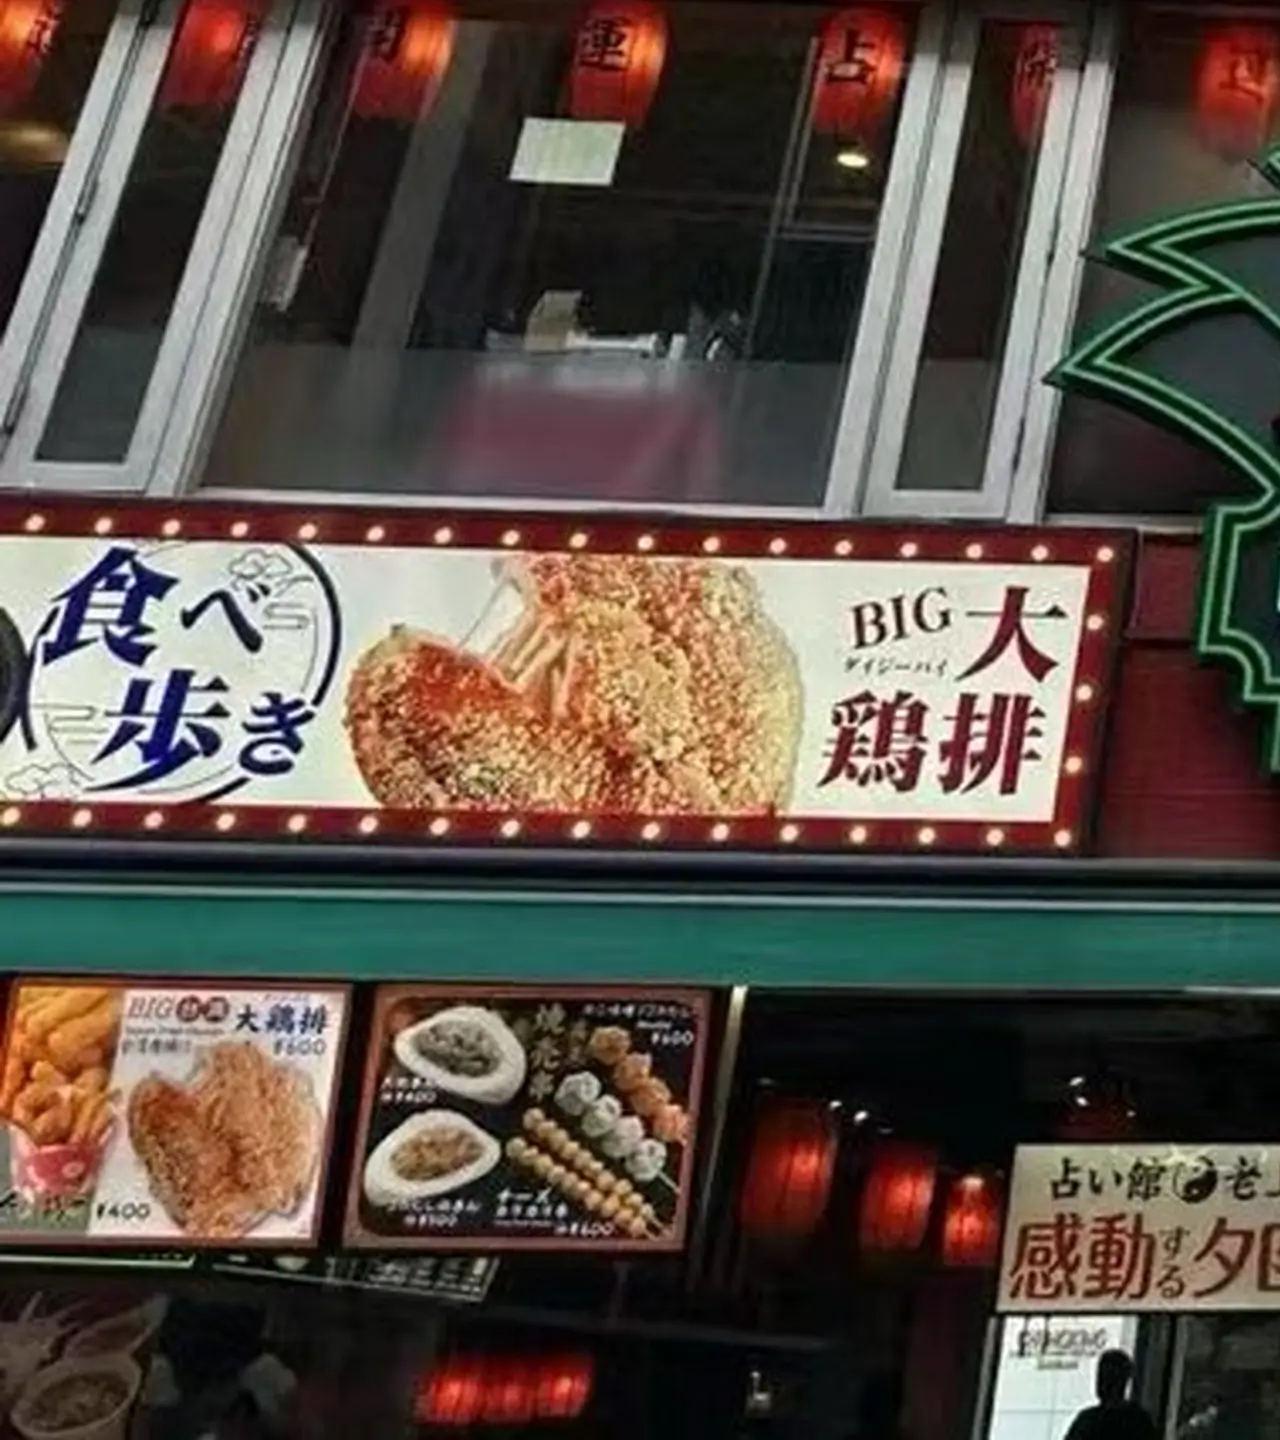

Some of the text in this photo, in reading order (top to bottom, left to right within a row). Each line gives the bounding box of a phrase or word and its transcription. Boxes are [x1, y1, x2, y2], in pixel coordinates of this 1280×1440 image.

[42, 543, 274, 668] 食べ
[851, 584, 1069, 684] BIG 大
[88, 667, 320, 792] 歩き
[816, 691, 1045, 799] 鶏排
[1050, 1157, 1166, 1201] 占い館
